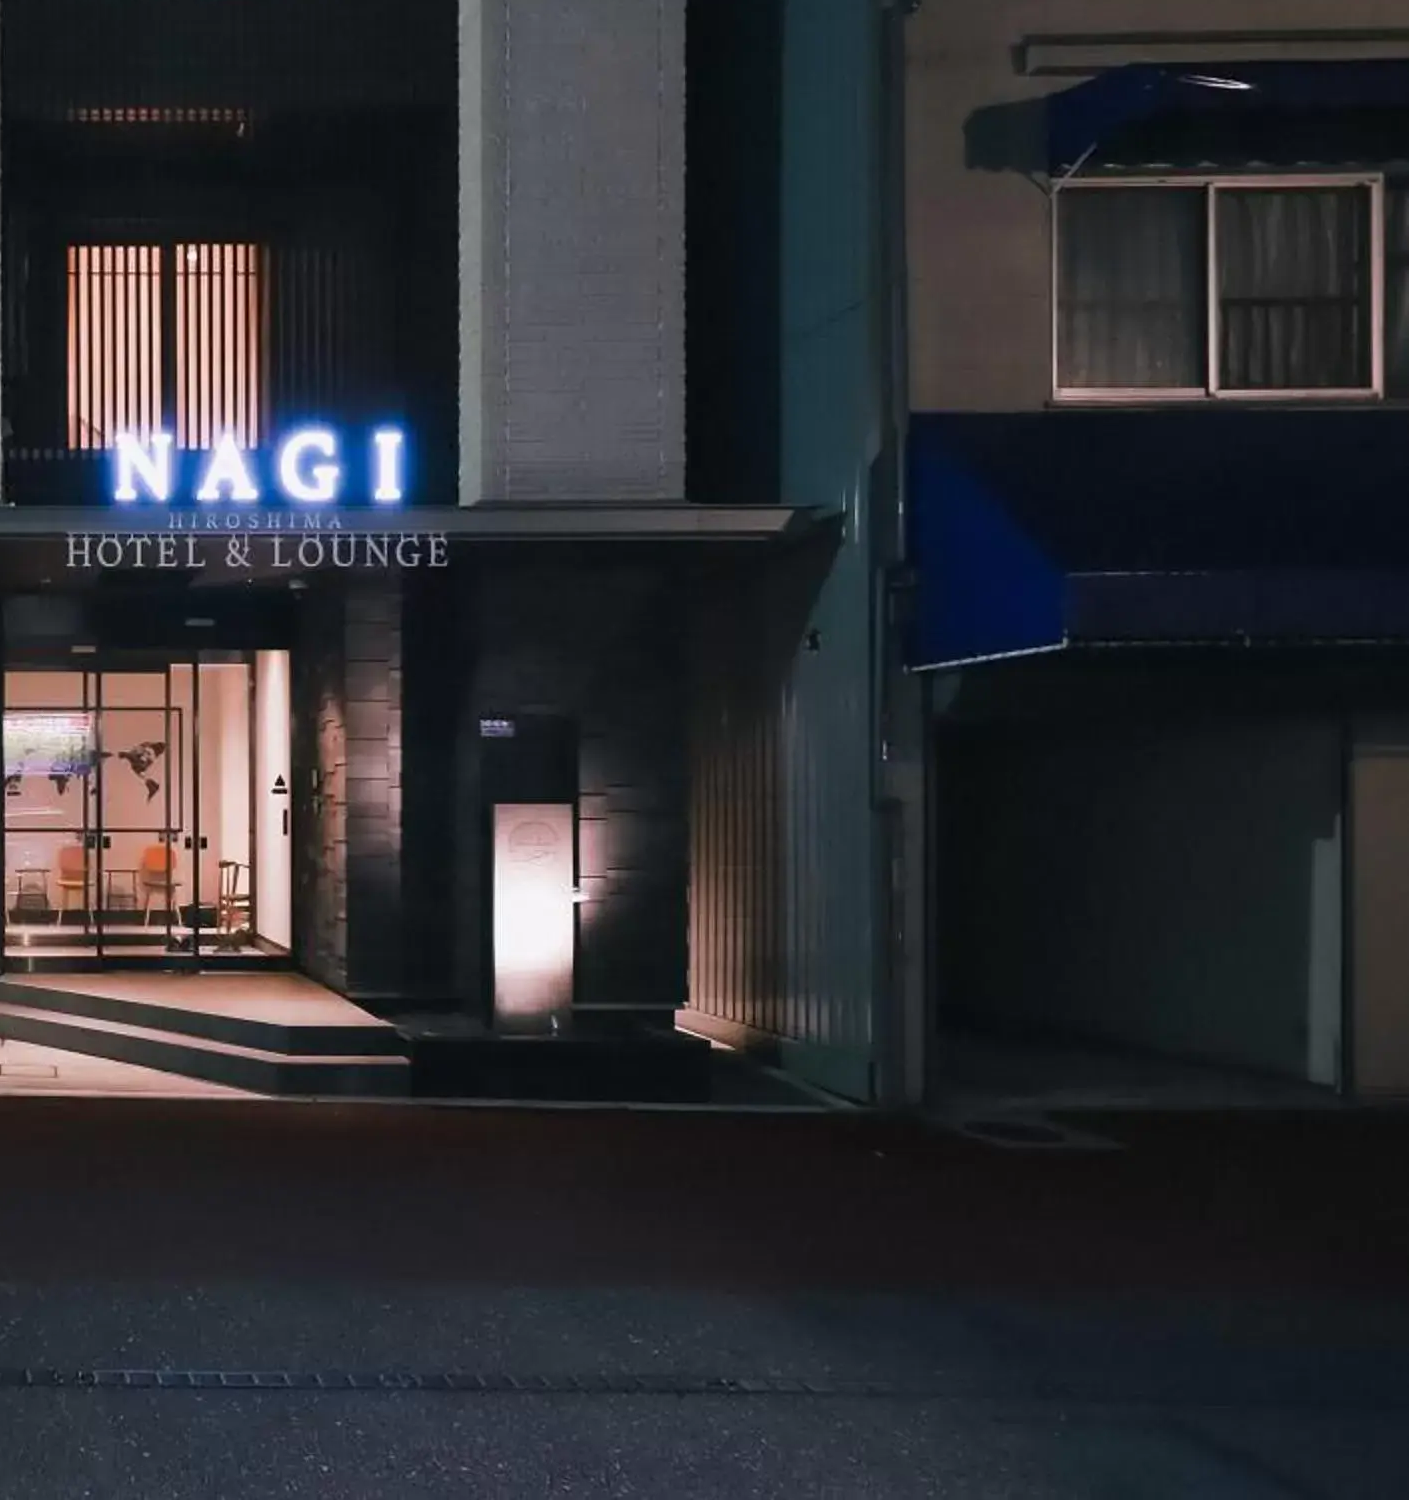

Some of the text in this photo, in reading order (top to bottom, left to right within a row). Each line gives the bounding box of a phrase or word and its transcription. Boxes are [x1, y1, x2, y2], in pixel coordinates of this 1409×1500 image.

[114, 431, 402, 501] NAGI
[168, 512, 343, 530] HIROSHIMA
[66, 536, 449, 568] HOTEL & LOUNGE
